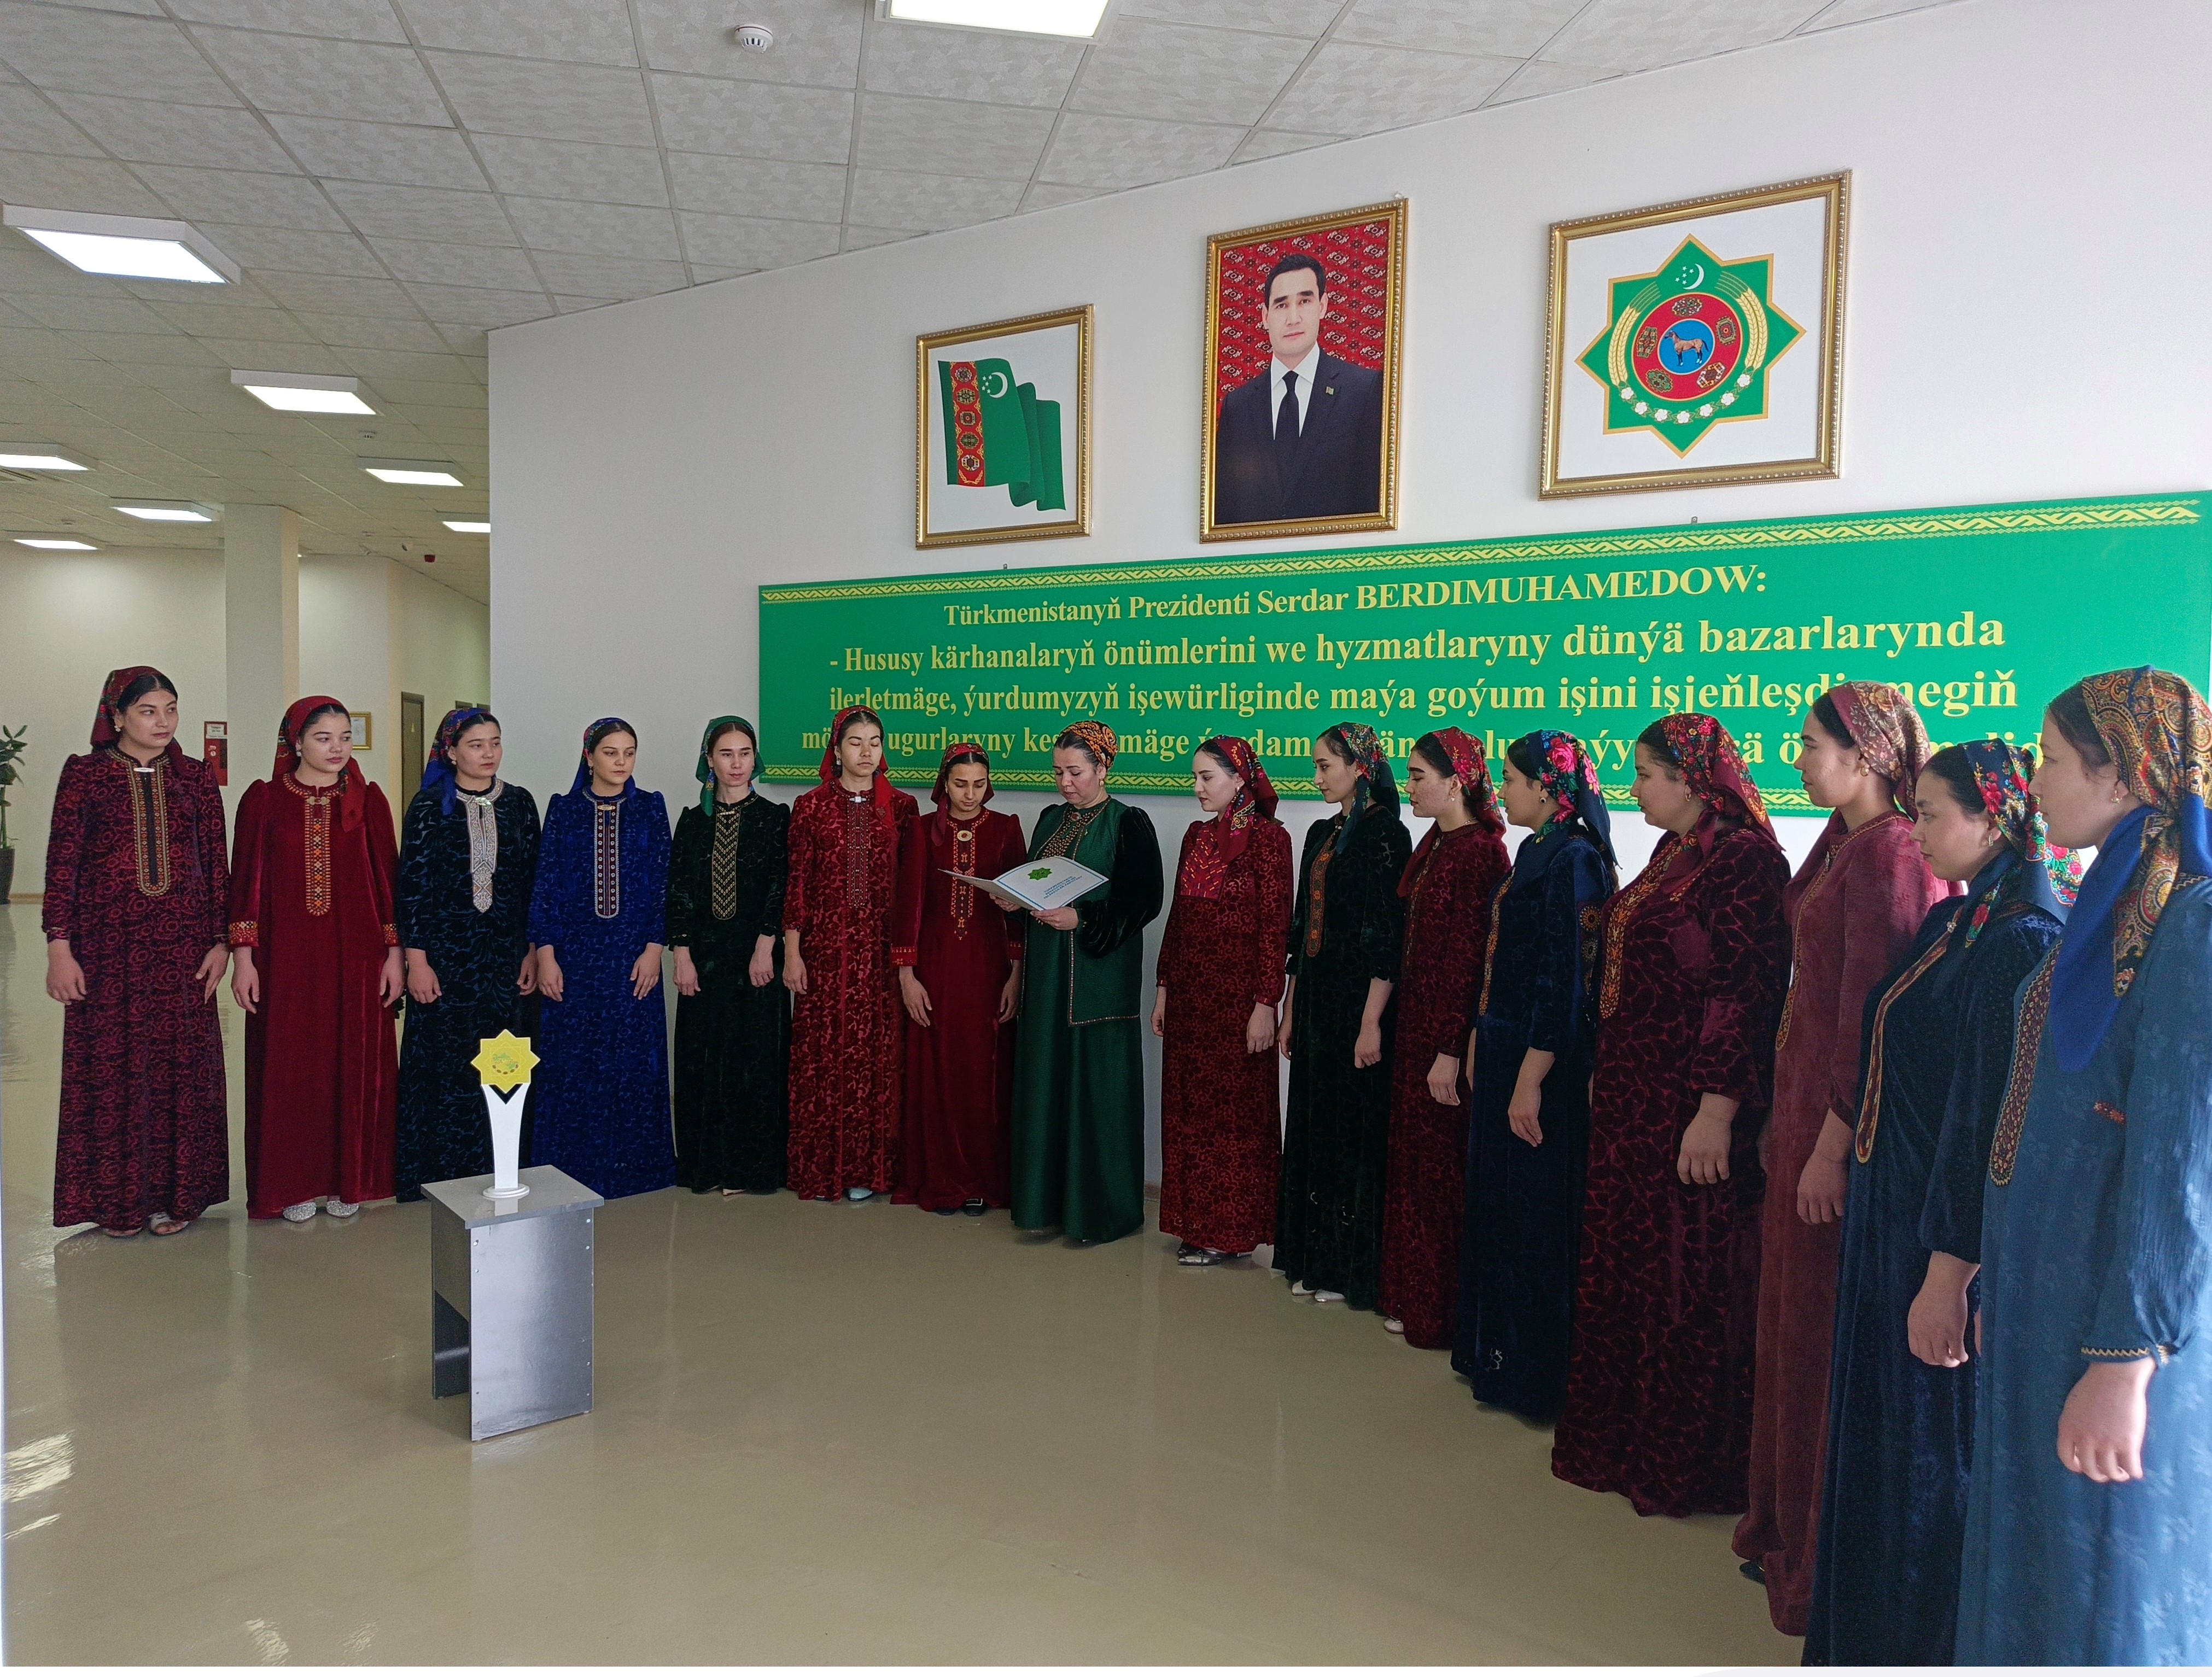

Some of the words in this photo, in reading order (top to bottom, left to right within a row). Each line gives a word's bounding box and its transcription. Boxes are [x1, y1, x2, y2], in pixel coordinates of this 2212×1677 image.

[944, 597, 1120, 626] Türkmenistanyň
[1129, 592, 1250, 617] Prezidenti
[1258, 588, 1349, 613] Serdar
[1356, 564, 1766, 610] BERDIMUHAMEDOW:
[845, 648, 923, 676] Hususy
[931, 640, 1095, 673] kärhanalaryň
[1105, 635, 1256, 665] önümlerini
[1265, 642, 1305, 662] we
[1316, 629, 1551, 669] hyzmatlaryny
[1563, 621, 1684, 663] dünýä
[1699, 611, 2005, 658] bazarlarynda
[831, 687, 956, 716] ilerletmäge,
[964, 683, 1119, 716] ýurdumyzyň
[1129, 682, 1319, 717] işewürliginde
[1330, 680, 1416, 717] maýa
[1428, 679, 1545, 717] goýum
[1559, 676, 1637, 716] işini
[1650, 669, 2018, 716] işjeňleşdegiň
